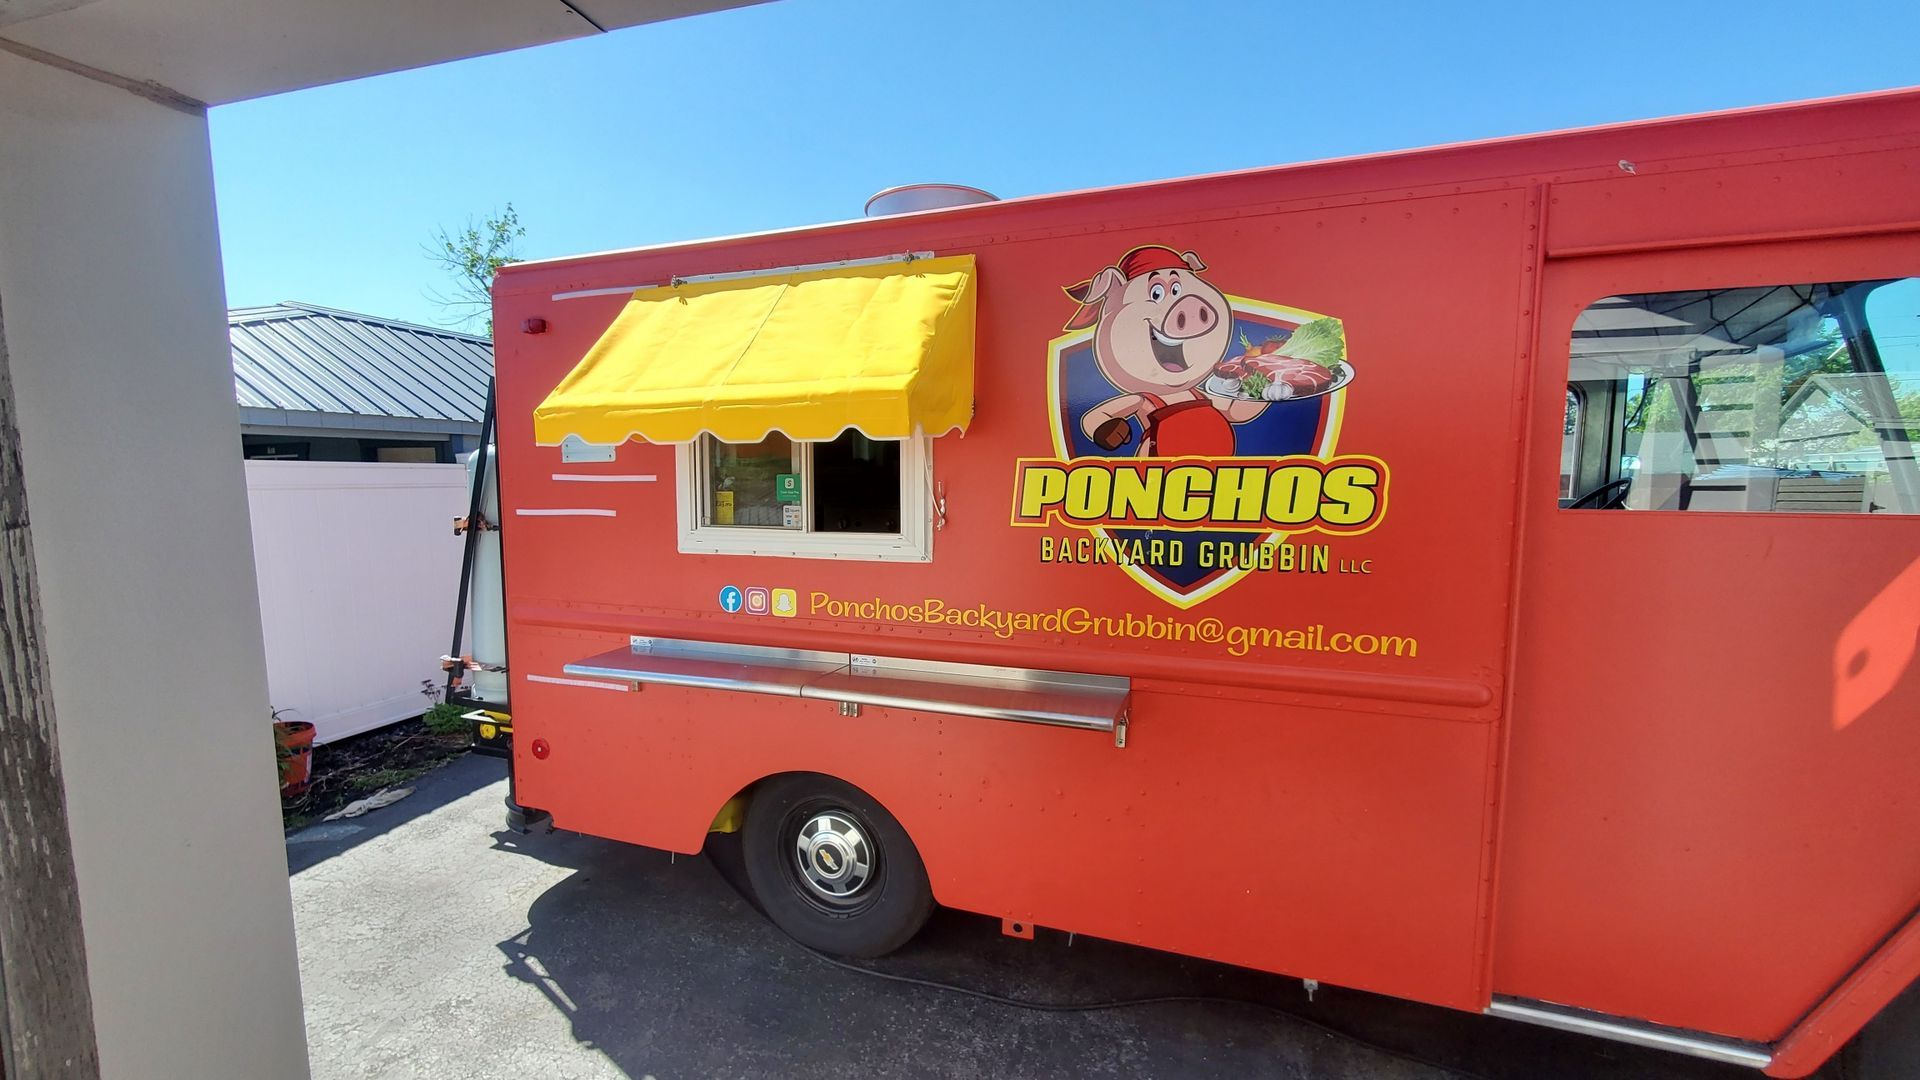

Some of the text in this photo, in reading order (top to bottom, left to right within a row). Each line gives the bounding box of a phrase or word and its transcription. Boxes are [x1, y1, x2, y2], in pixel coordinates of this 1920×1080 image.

[1020, 464, 1378, 526] PONCHOS
[1040, 536, 1372, 574] BACKYARD GRUBBIN LLC
[810, 591, 1418, 656] PonchosBackyardGrubbin@gmail.com
